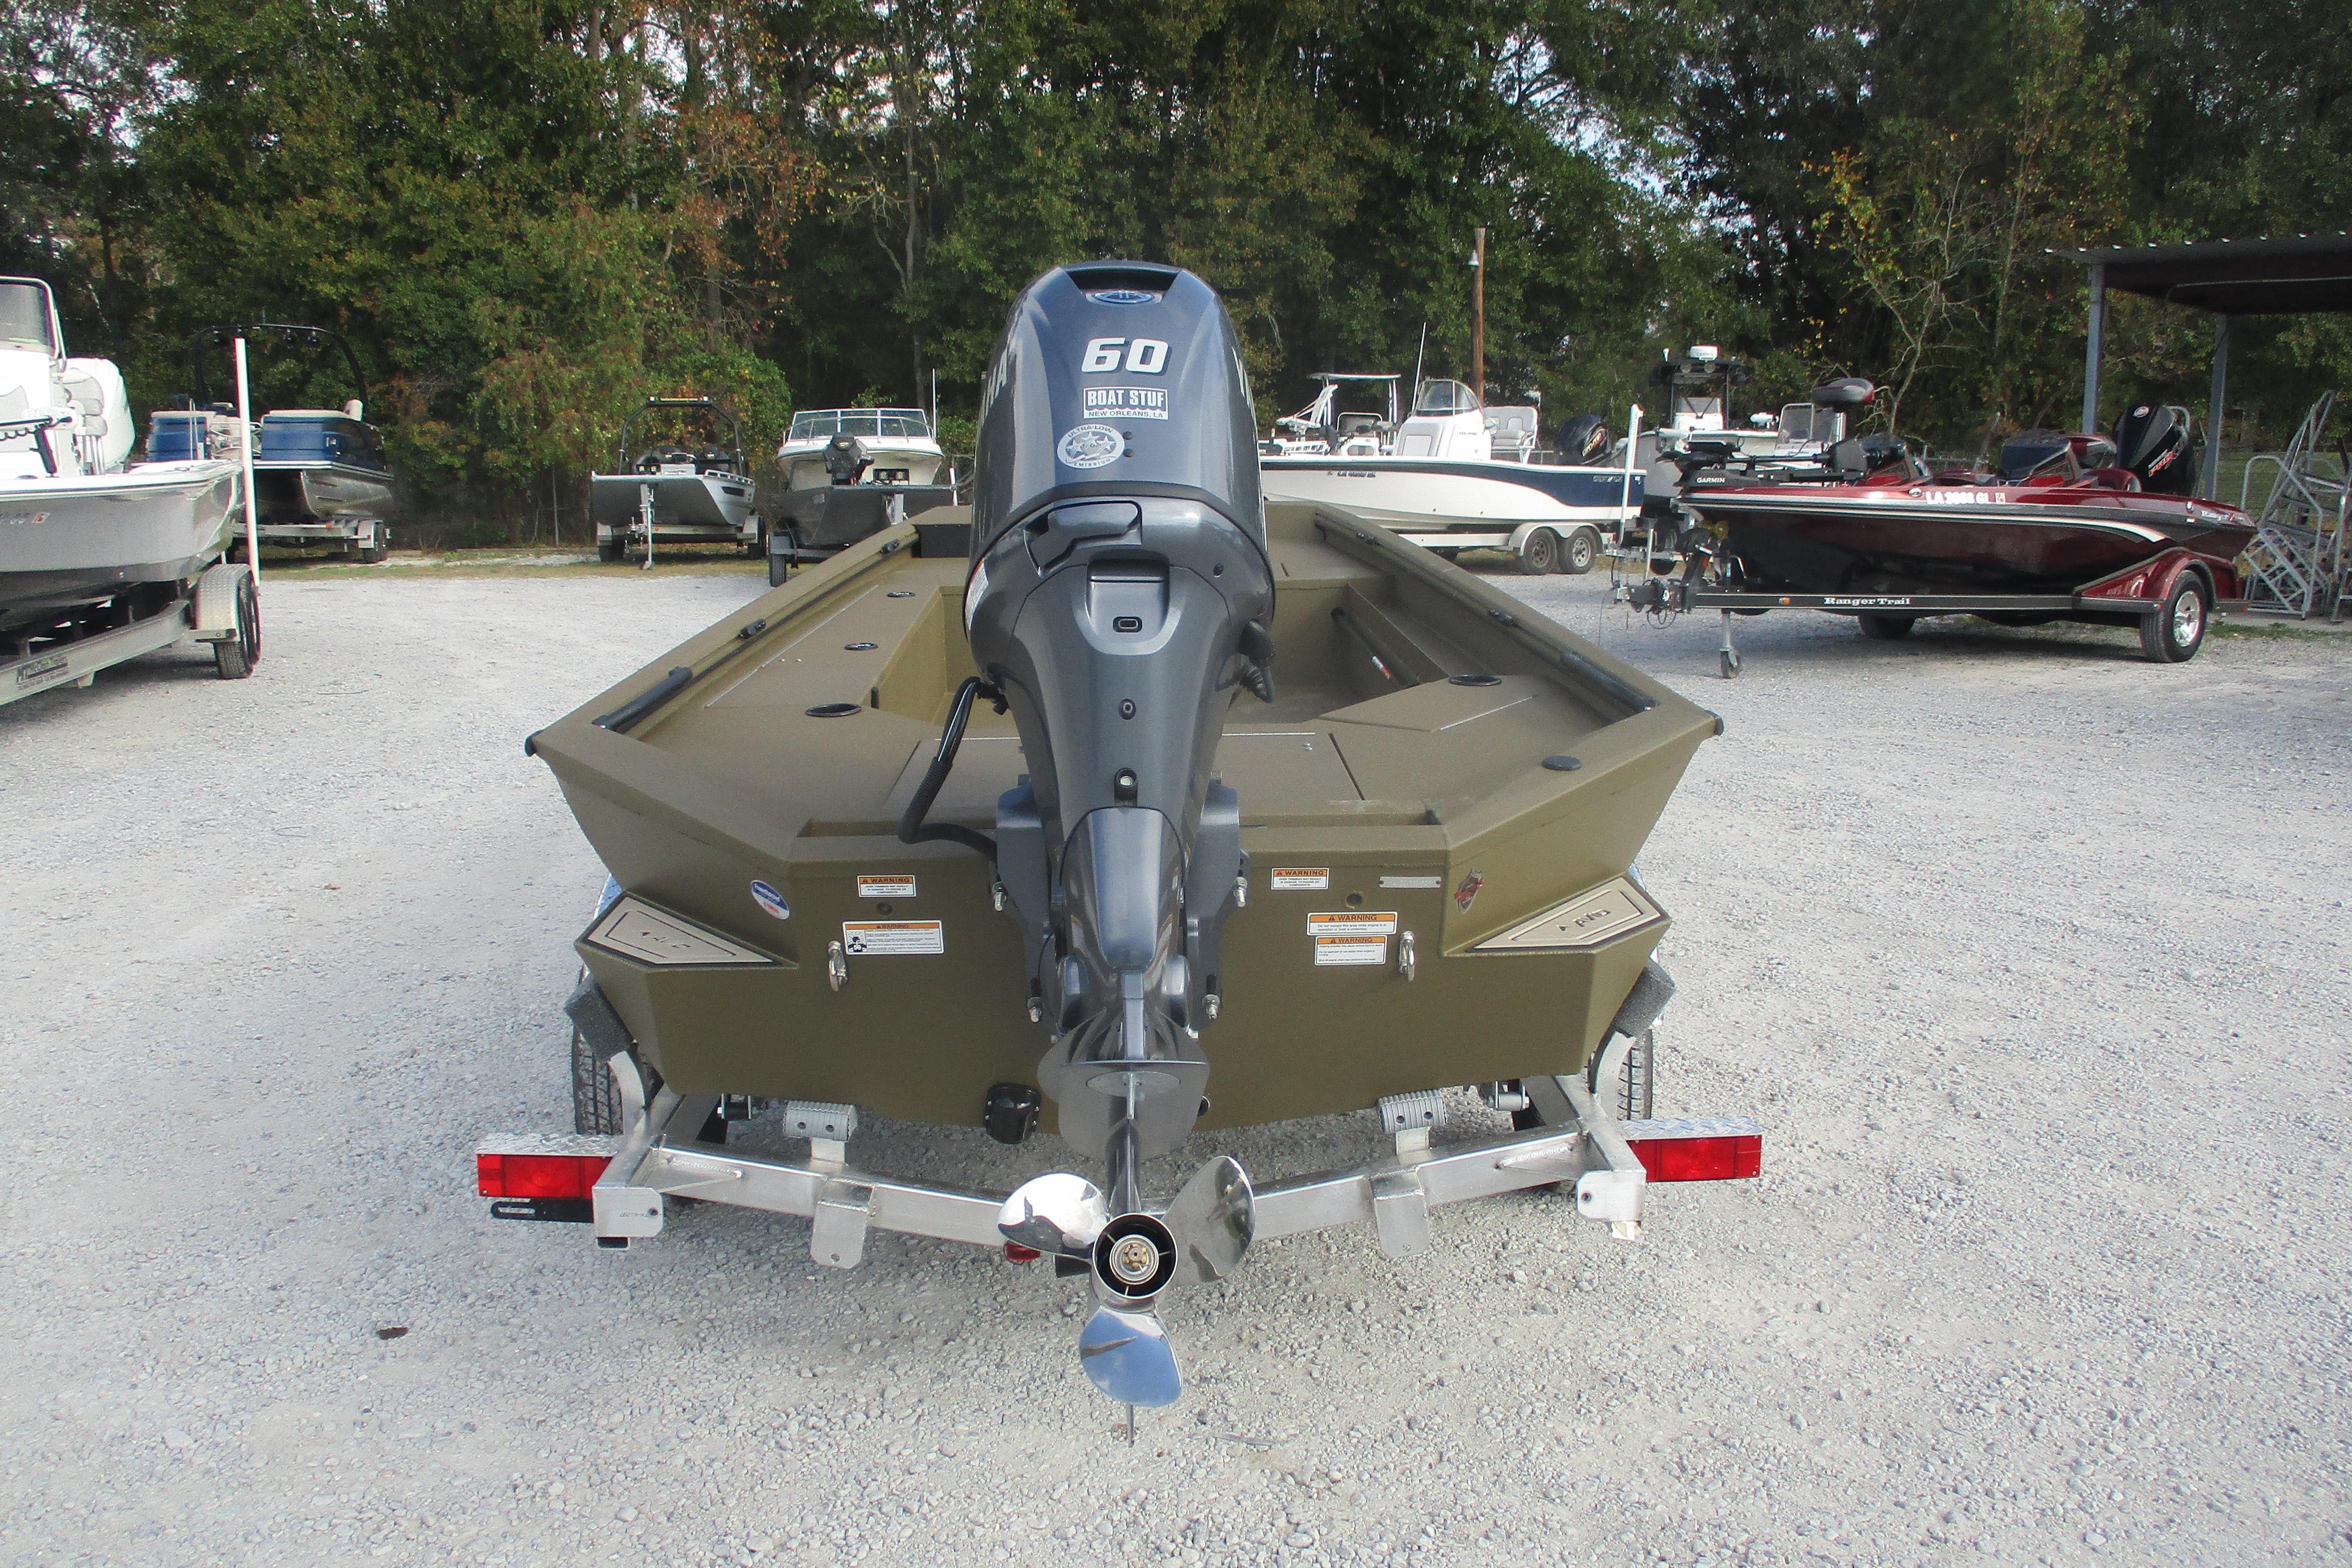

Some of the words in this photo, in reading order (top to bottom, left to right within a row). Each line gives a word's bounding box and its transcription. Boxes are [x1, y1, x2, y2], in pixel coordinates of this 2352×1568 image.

[1081, 337, 1170, 374] 60
[1087, 390, 1124, 406] BOAT
[1129, 390, 1164, 407] STUF
[1074, 458, 1111, 467] EMISSION
[1926, 491, 1944, 505] LA
[1823, 598, 1876, 606] Ranger
